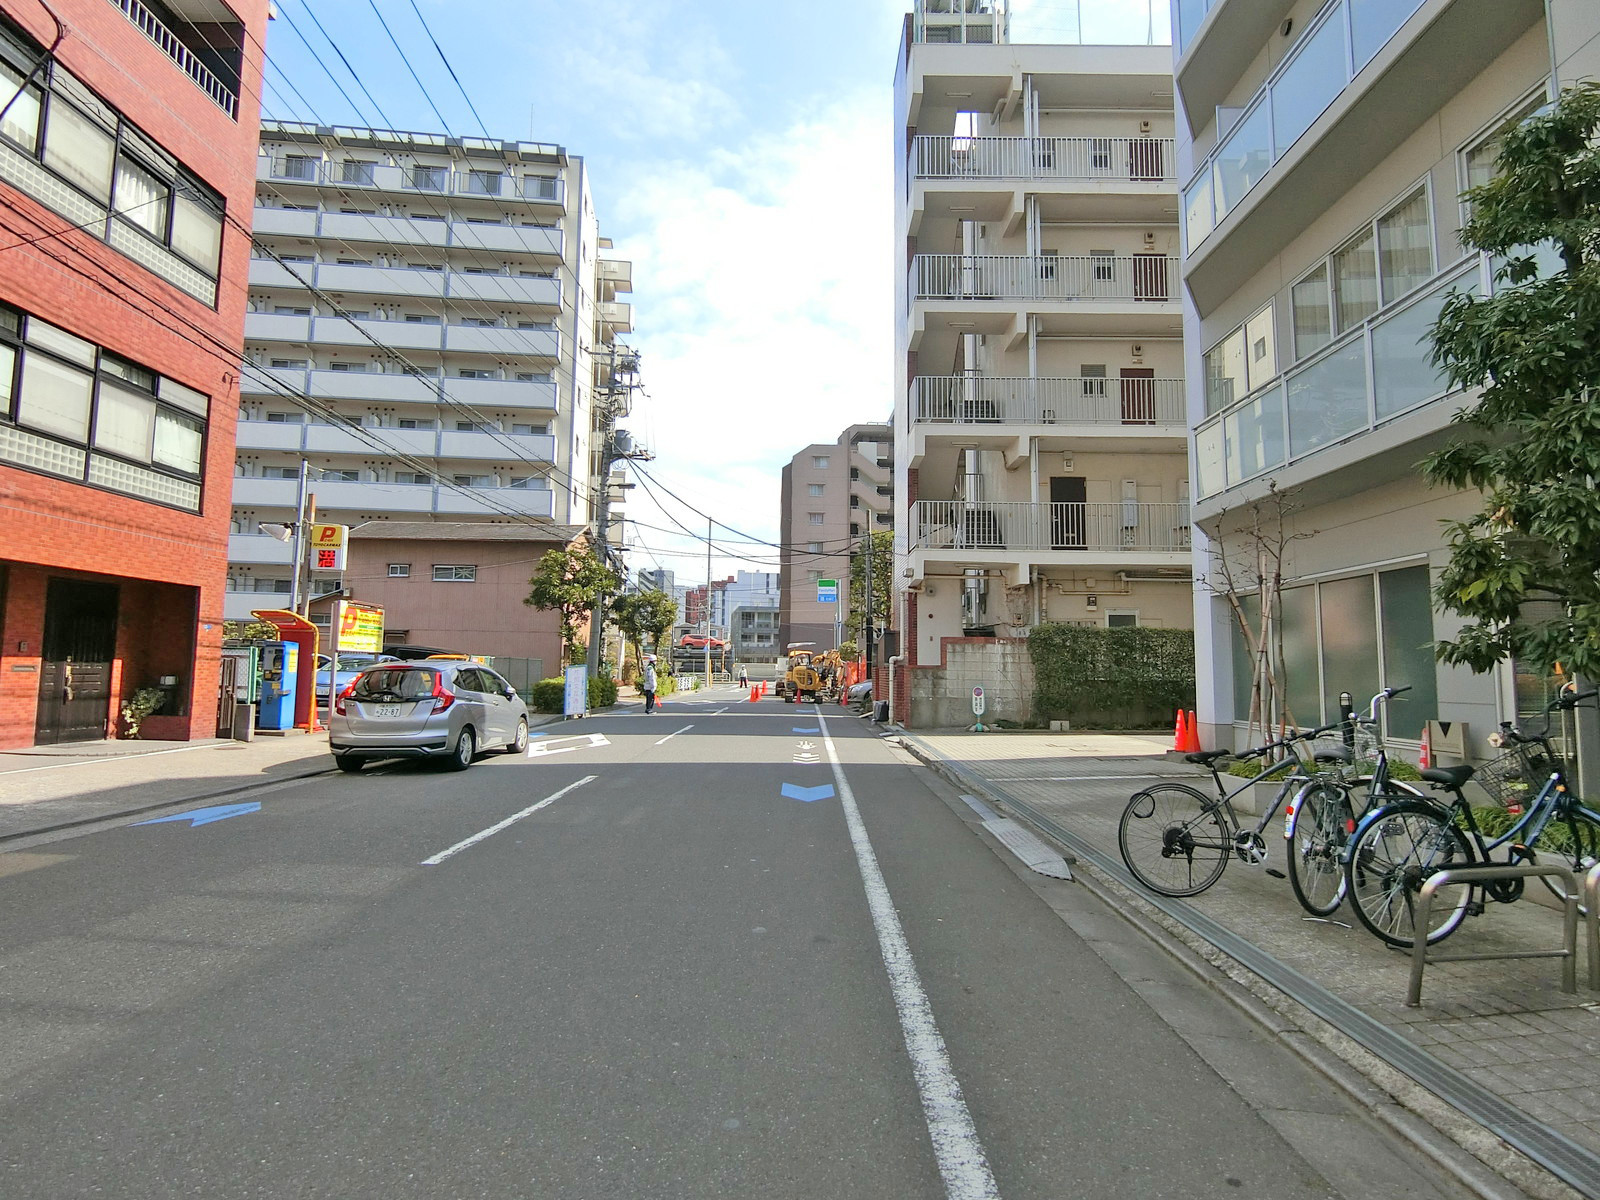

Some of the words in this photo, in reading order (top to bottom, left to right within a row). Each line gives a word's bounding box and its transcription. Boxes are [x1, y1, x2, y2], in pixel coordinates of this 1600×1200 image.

[320, 526, 336, 541] P
[318, 550, 335, 567] 満
[340, 607, 357, 636] P
